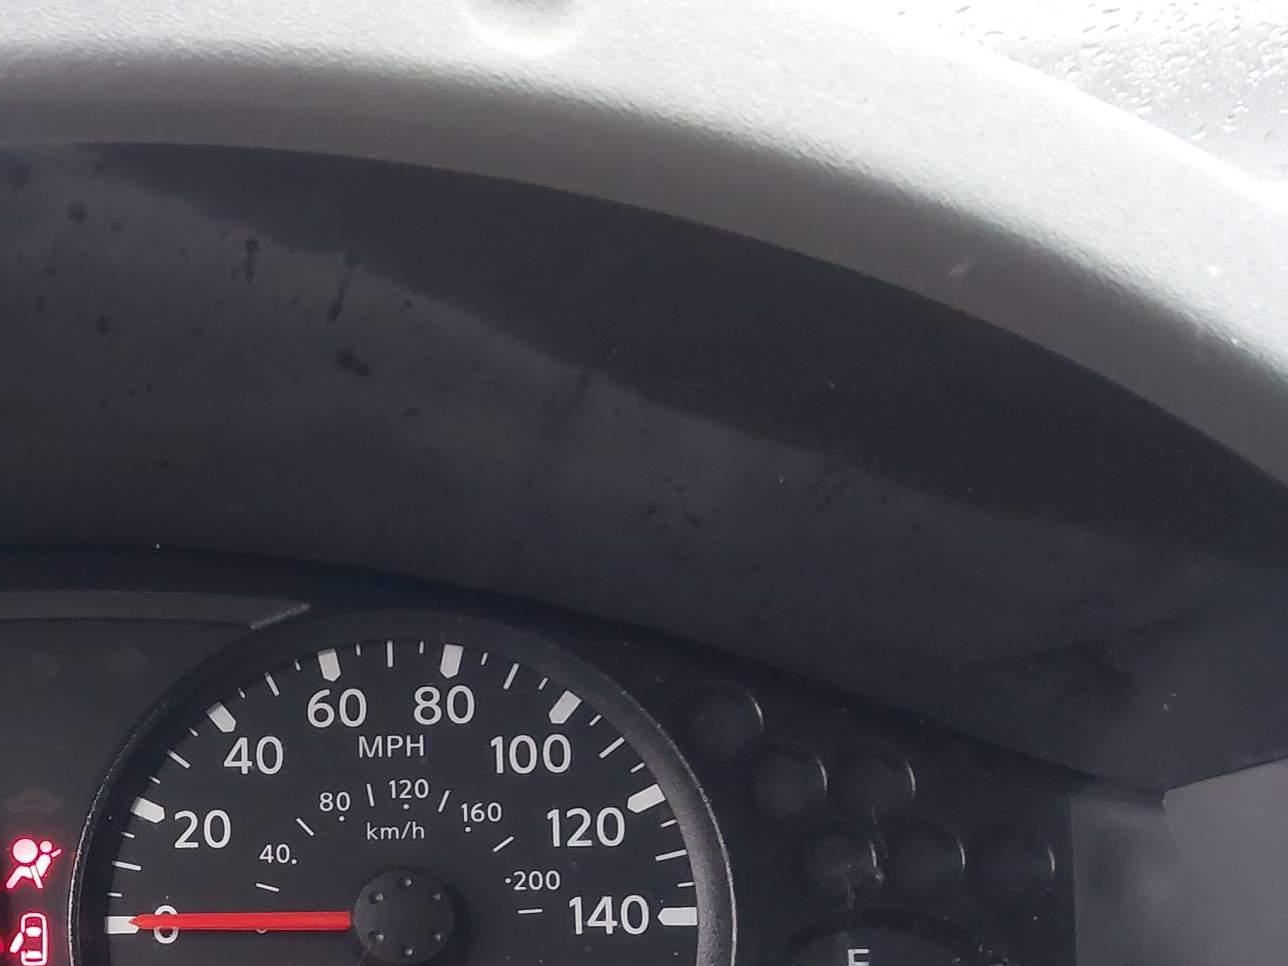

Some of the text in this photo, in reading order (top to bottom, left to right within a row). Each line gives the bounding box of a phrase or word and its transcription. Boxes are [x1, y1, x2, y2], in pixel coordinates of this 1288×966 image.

[308, 689, 366, 727] 60
[414, 686, 474, 725] 80
[224, 736, 283, 774] 40
[359, 735, 423, 758] MPH
[491, 734, 571, 773] 100
[320, 792, 350, 811] 80
[389, 779, 428, 798] 120
[461, 803, 501, 822] 160
[547, 808, 624, 846] 120
[175, 810, 230, 848] 20
[366, 822, 425, 840] km/h
[260, 844, 289, 863] 40
[514, 871, 560, 890] 200
[570, 895, 649, 934] 140
